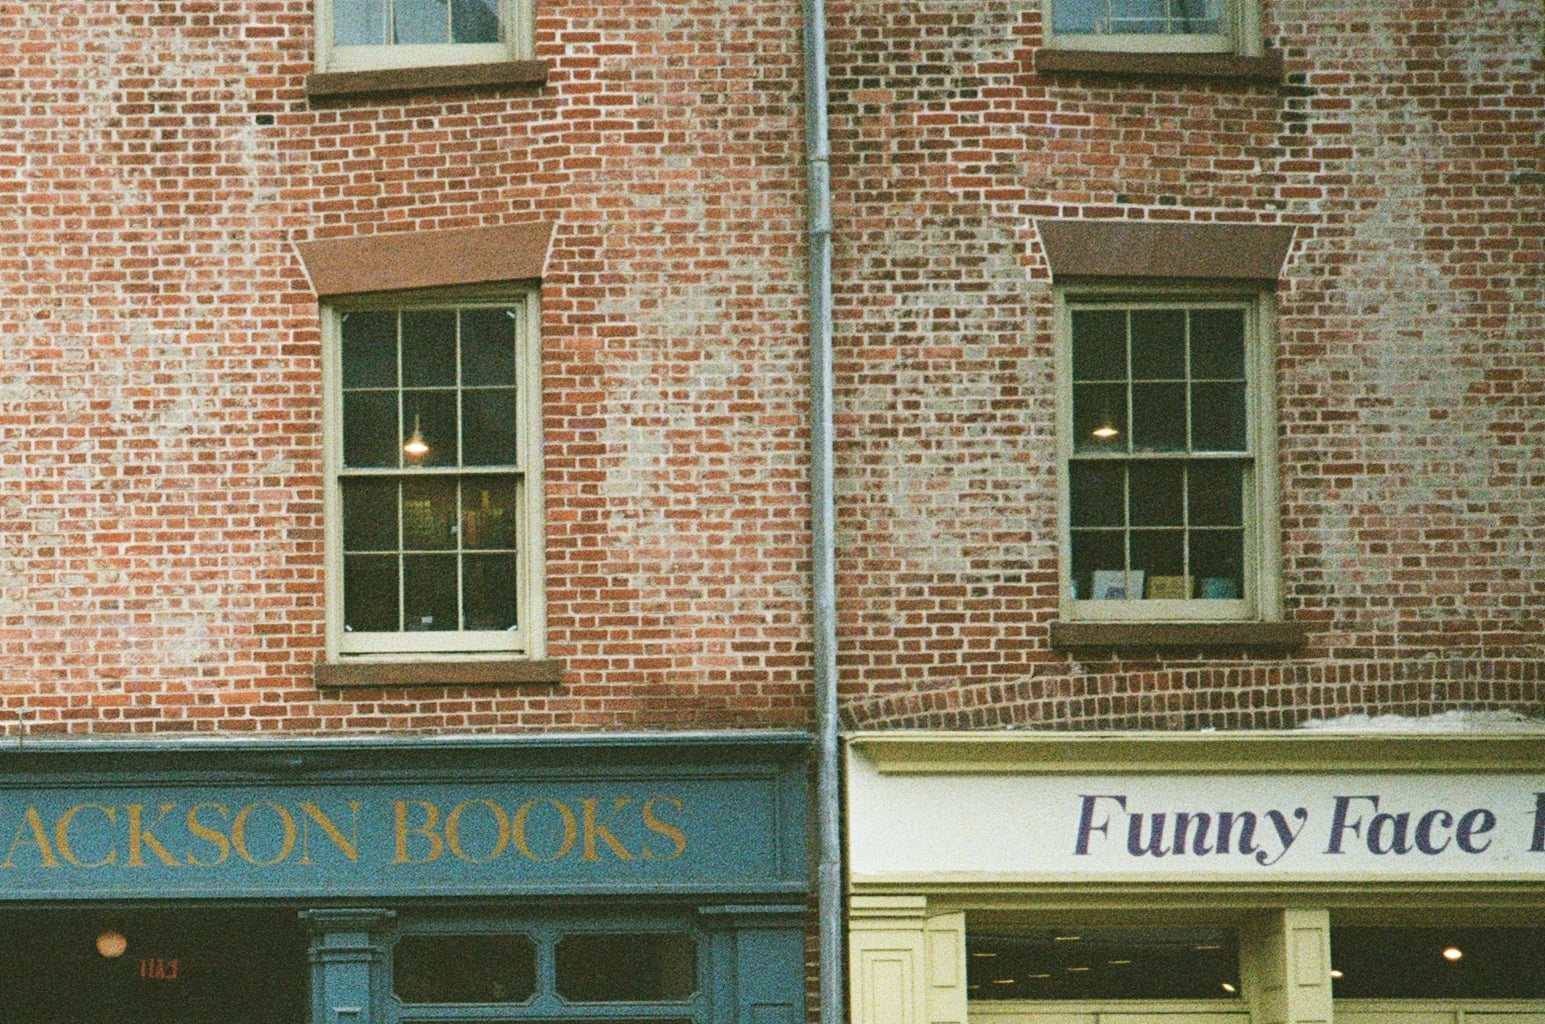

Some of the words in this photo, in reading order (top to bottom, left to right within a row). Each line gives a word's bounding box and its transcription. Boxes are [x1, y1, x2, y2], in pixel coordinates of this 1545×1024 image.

[390, 796, 687, 864] BOOKS
[1073, 793, 1308, 866] Funny
[1322, 794, 1497, 858] Face
